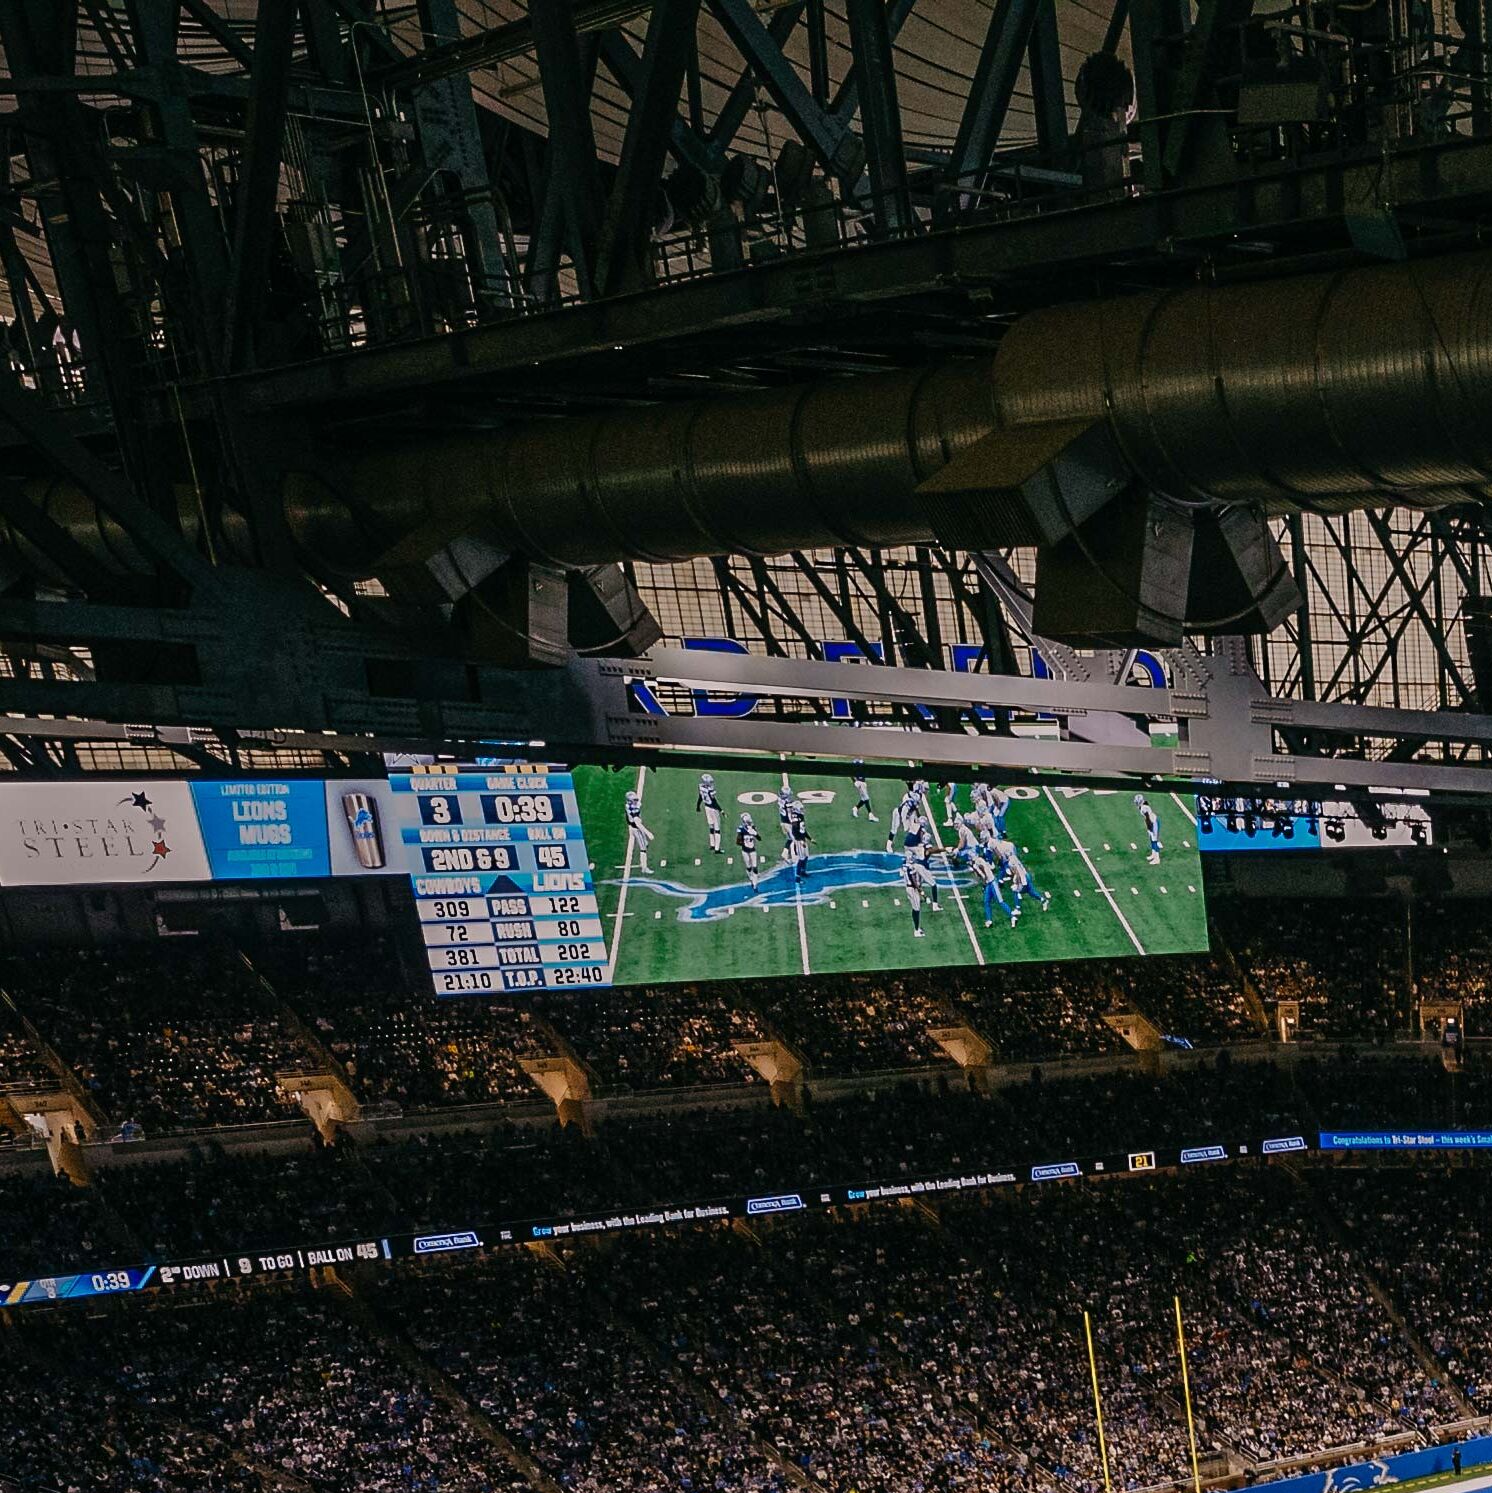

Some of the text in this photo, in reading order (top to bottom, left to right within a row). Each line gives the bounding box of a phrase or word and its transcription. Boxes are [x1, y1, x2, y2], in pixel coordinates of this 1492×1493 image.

[232, 801, 287, 821] LIONS
[431, 796, 553, 824] 3 0:39
[239, 824, 292, 844] MUGS
[24, 836, 144, 858] STEEL
[432, 847, 566, 871] 2ND & 9 45
[416, 873, 586, 895] COWBOYS LIONS
[434, 897, 580, 917] 309 PASS 122
[446, 921, 580, 941] 72 RUSH 80
[446, 944, 590, 966] 381 TOTAL 202
[444, 973, 491, 990] 21:10
[554, 966, 603, 984] 22:40
[1134, 1156, 1148, 1168] 21
[183, 1263, 220, 1280] DOWN
[259, 1257, 275, 1271] TO
[277, 1256, 294, 1269] GO
[307, 1249, 336, 1265] BALL
[337, 1247, 353, 1261] ON
[92, 1272, 129, 1290] 0:39
